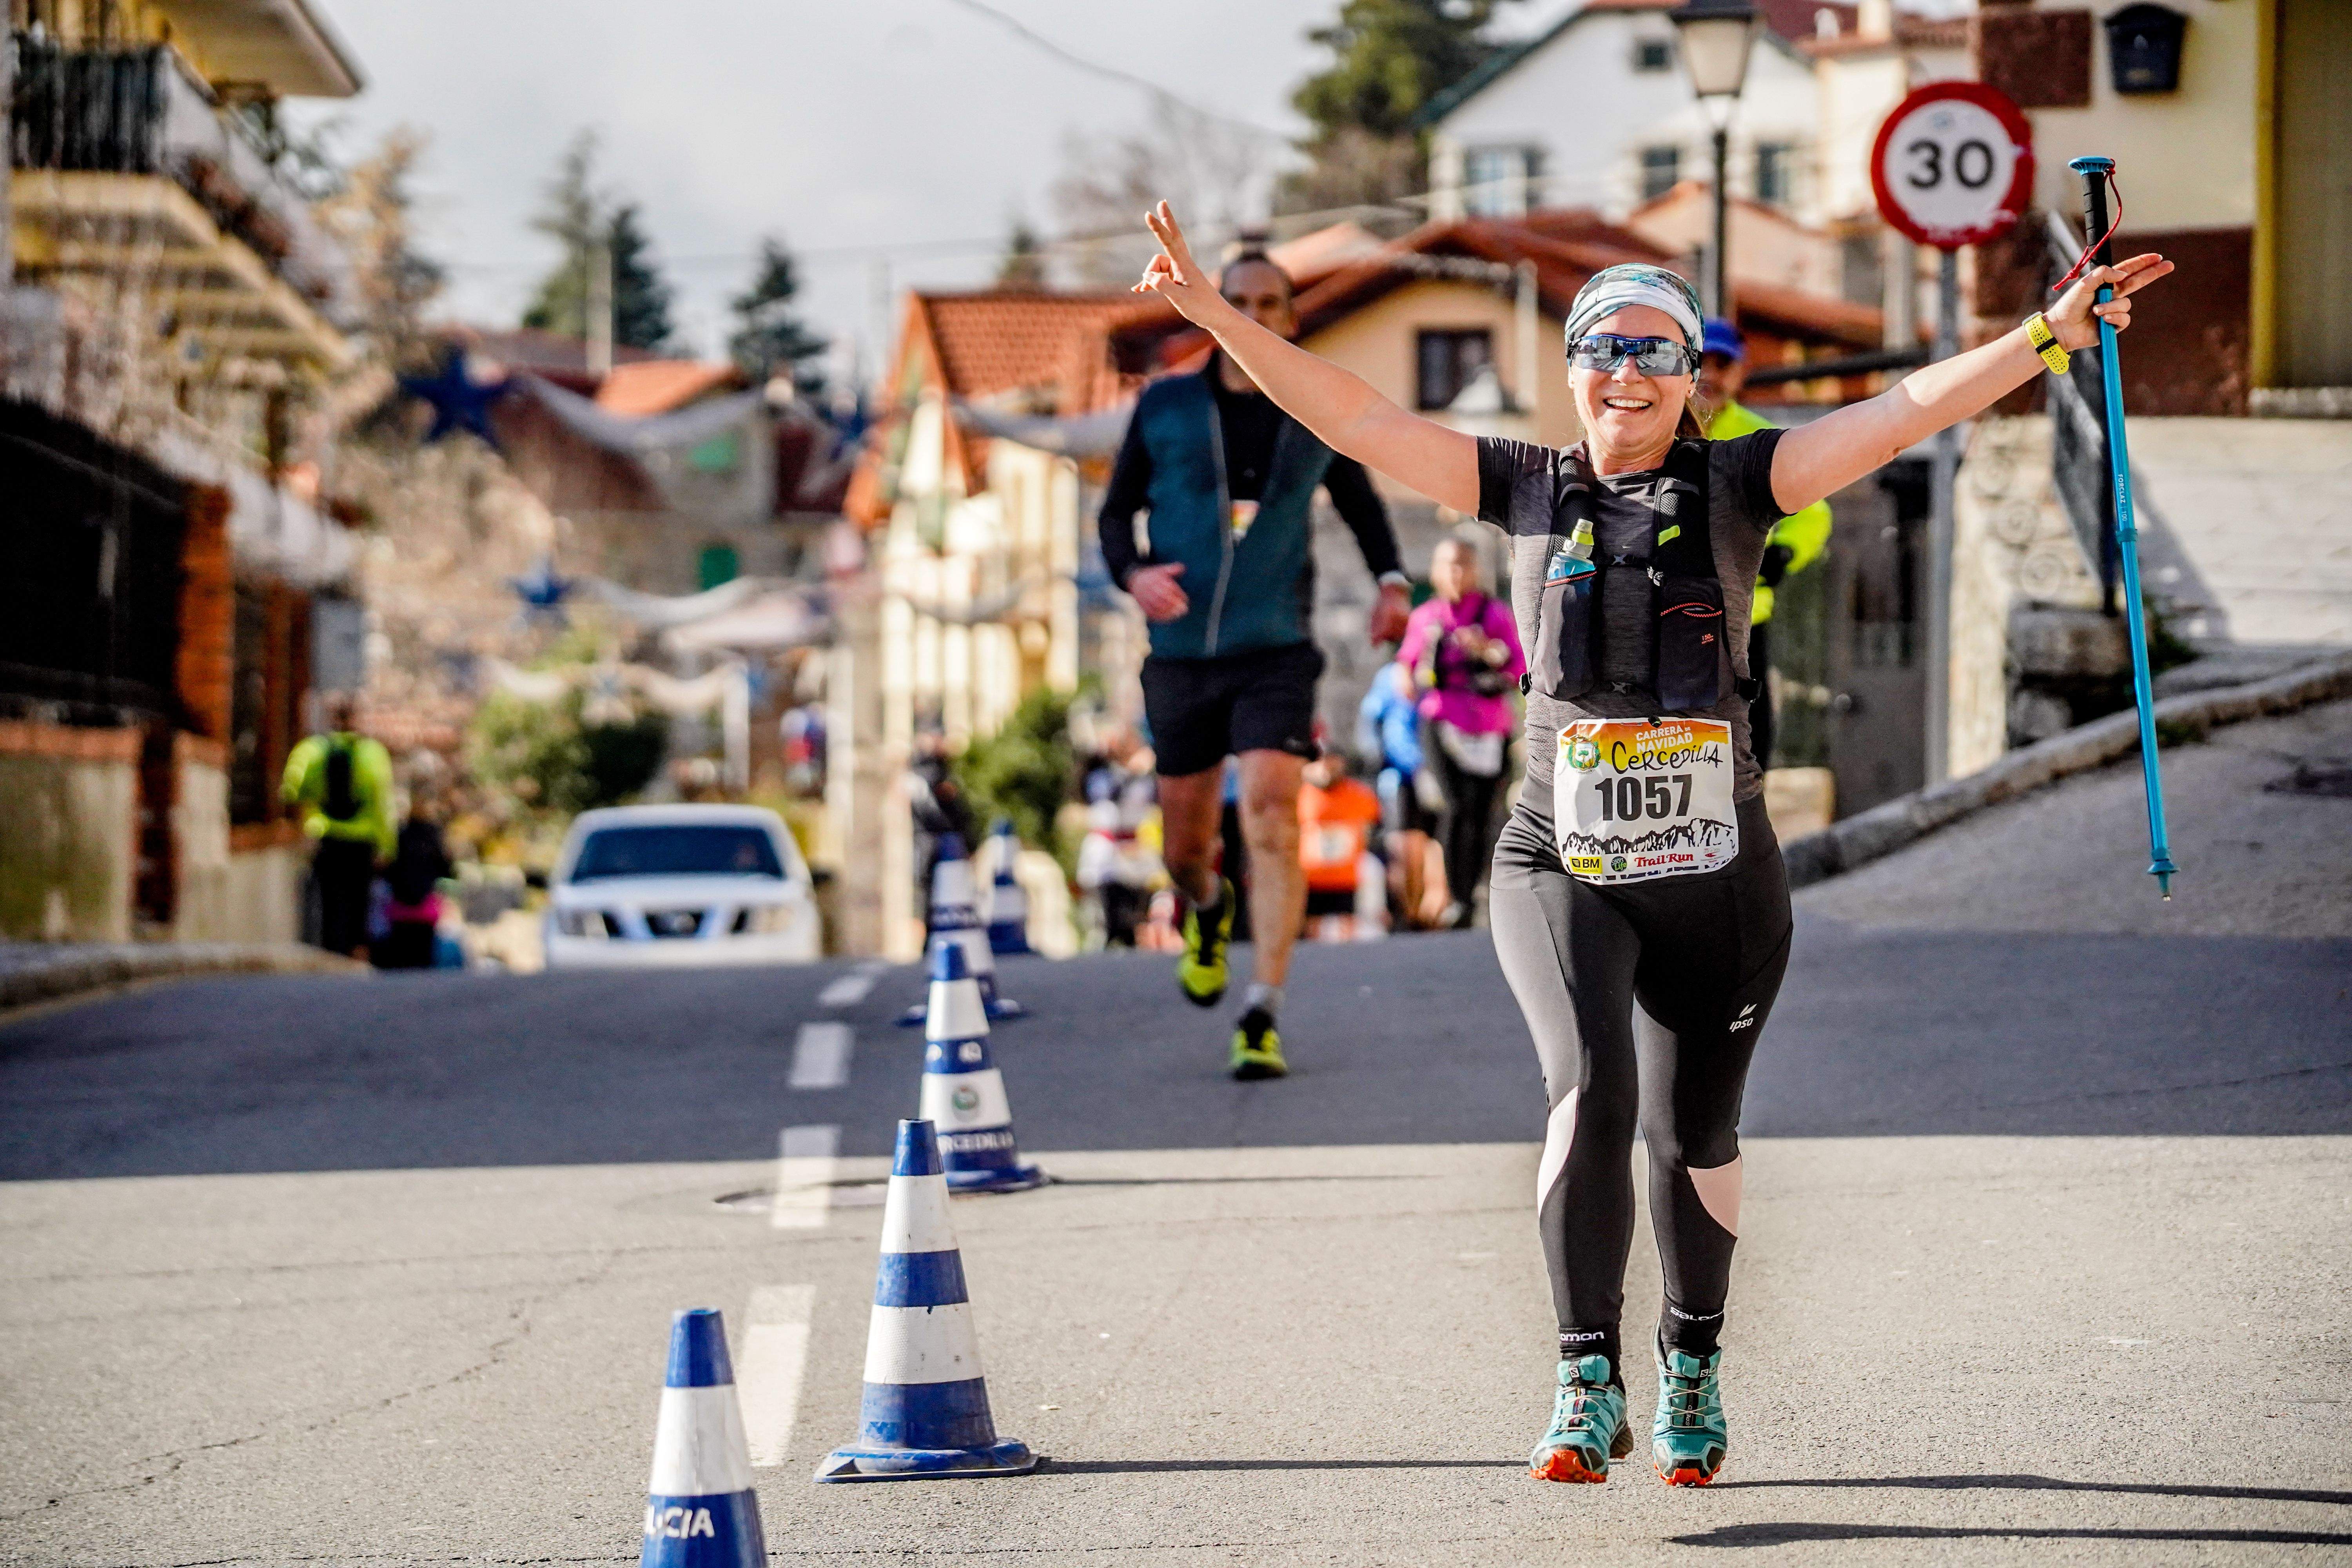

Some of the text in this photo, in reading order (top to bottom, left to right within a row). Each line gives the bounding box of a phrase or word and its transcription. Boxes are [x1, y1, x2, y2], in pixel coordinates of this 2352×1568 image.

[1907, 139, 1994, 189] 30
[1636, 725, 1684, 741] CARRERA
[1636, 732, 1693, 753] NAVIDAD
[1595, 774, 1692, 821] 1057
[1583, 858, 1600, 868] BM
[1635, 855, 1665, 867] Trail
[1666, 853, 1694, 863] Run
